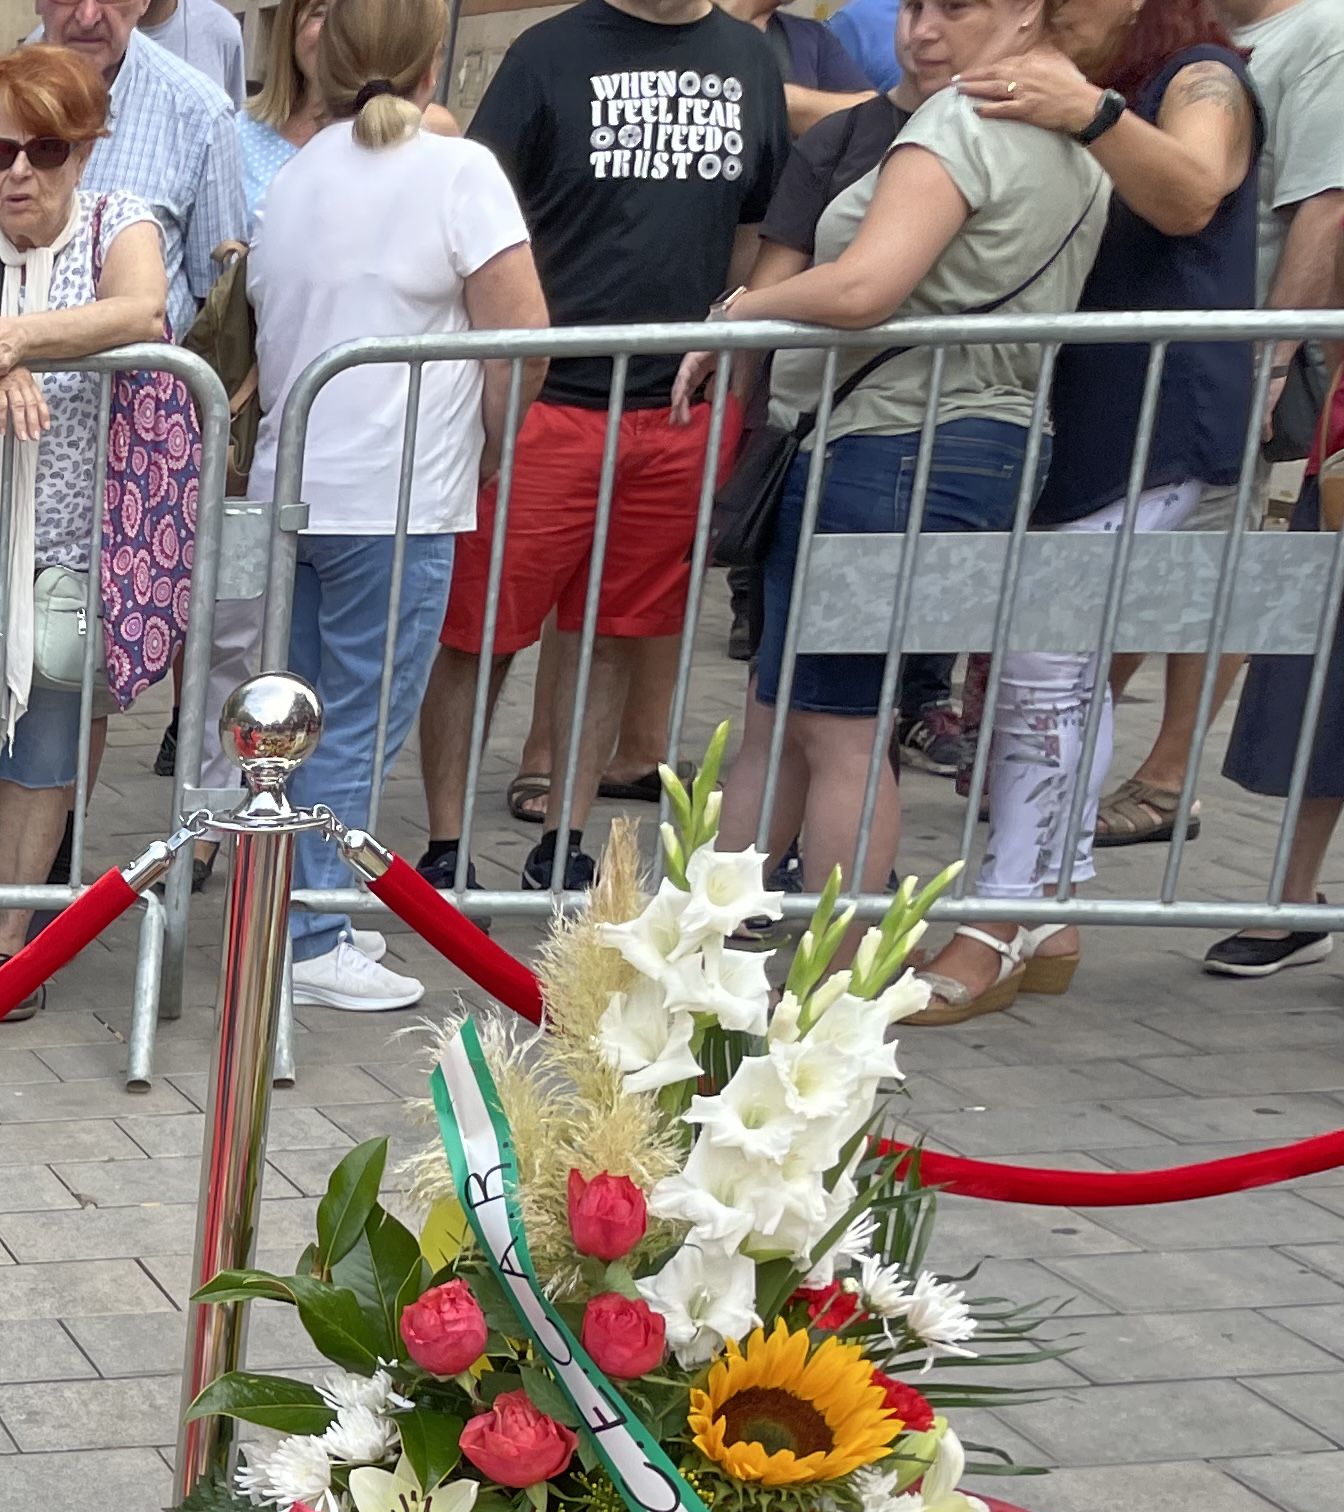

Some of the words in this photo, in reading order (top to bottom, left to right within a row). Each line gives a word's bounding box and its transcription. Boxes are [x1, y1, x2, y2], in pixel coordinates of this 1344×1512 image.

[590, 70, 677, 100] WHEN
[590, 100, 602, 127] I
[607, 97, 673, 126] FEEL
[678, 97, 741, 130] FEAR
[643, 123, 653, 150] I
[656, 123, 723, 152] FEED
[589, 149, 693, 179] TRUST
